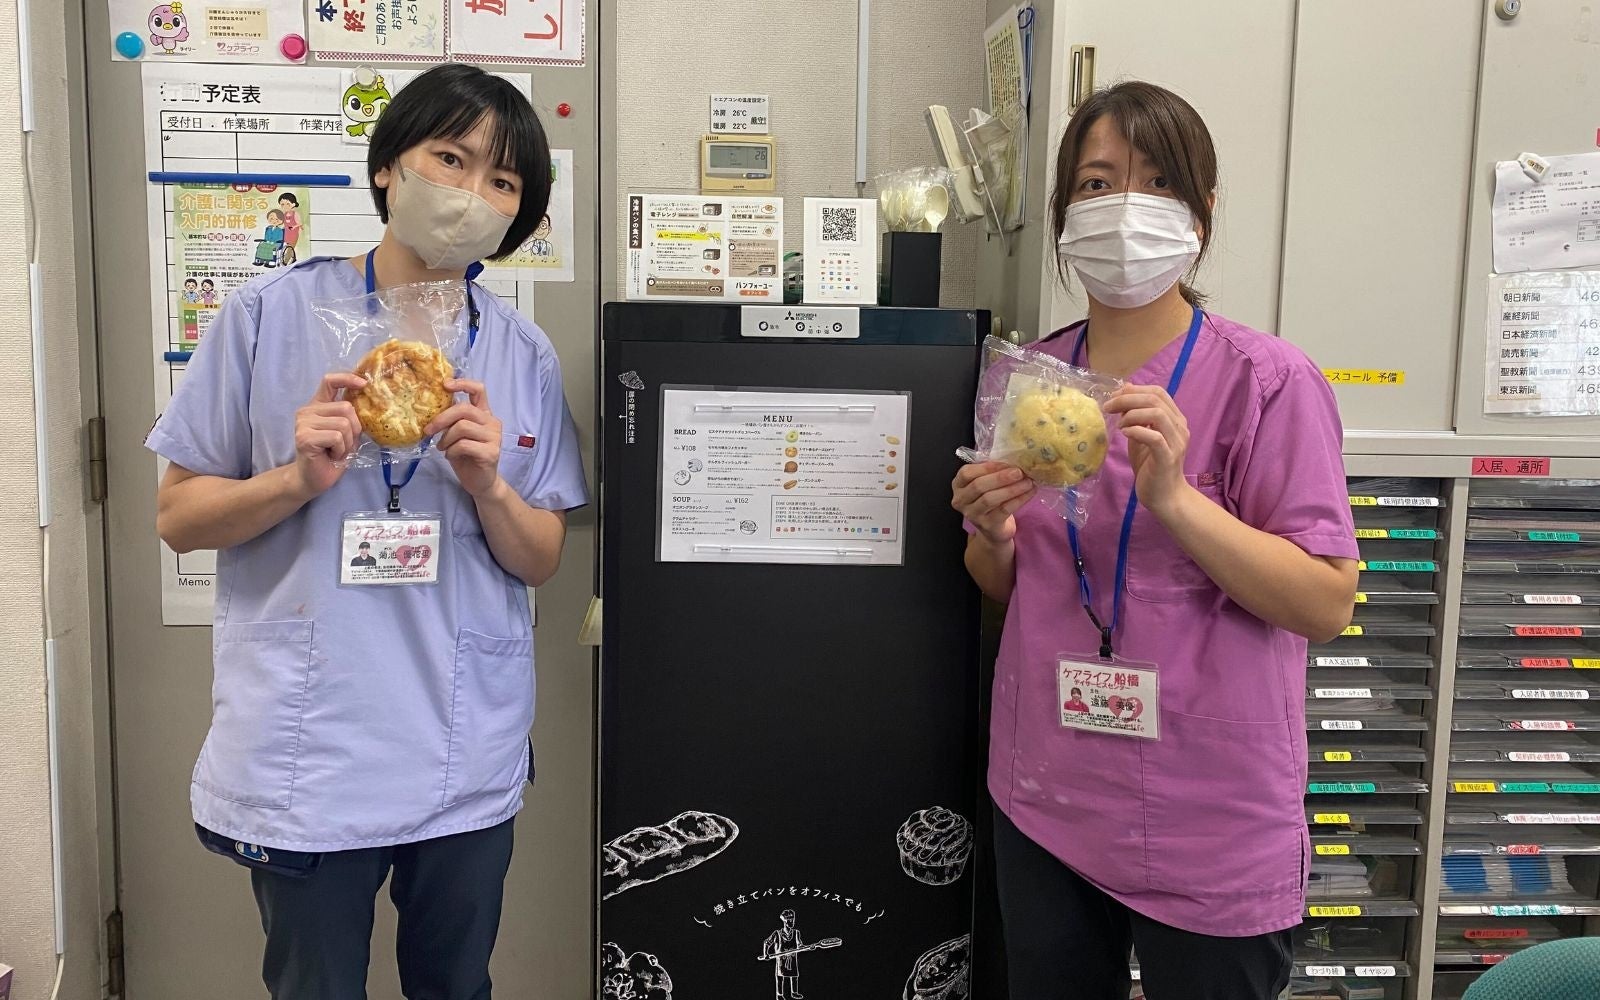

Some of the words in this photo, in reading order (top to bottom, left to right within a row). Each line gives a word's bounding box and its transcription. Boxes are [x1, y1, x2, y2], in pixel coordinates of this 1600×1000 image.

[376, 0, 386, 46] ご用のあ
[168, 116, 202, 129] 受付日
[222, 118, 270, 130] 作業場所
[299, 118, 342, 131] 作業内容
[754, 150, 766, 160] 26
[180, 192, 268, 210] 介護に関する
[180, 213, 257, 230] 入門的研修
[632, 198, 640, 246] 冷凍パンの食べ方
[1503, 292, 1541, 302] 朝日新聞
[1502, 311, 1540, 321] 産経新聞
[1579, 319, 1600, 329] 46
[1502, 329, 1558, 339] 日本経済新聞
[1501, 348, 1539, 358] 読売新聞
[1500, 366, 1538, 377] 聖教新聞
[1378, 372, 1397, 383] 予備
[1500, 385, 1537, 395] 東京新聞
[763, 415, 794, 423] MENU
[1476, 460, 1544, 474] 入居、通所
[407, 524, 431, 536] 船橋
[379, 550, 397, 559] 菊池
[178, 578, 210, 586] Memo
[1063, 668, 1111, 682] ケアライフ
[1114, 672, 1139, 687] 船橋
[1074, 679, 1130, 690] デイサービスセンター
[1091, 698, 1109, 708] 遠藤
[713, 886, 862, 915] 焼き立てパンをオフィスでも
